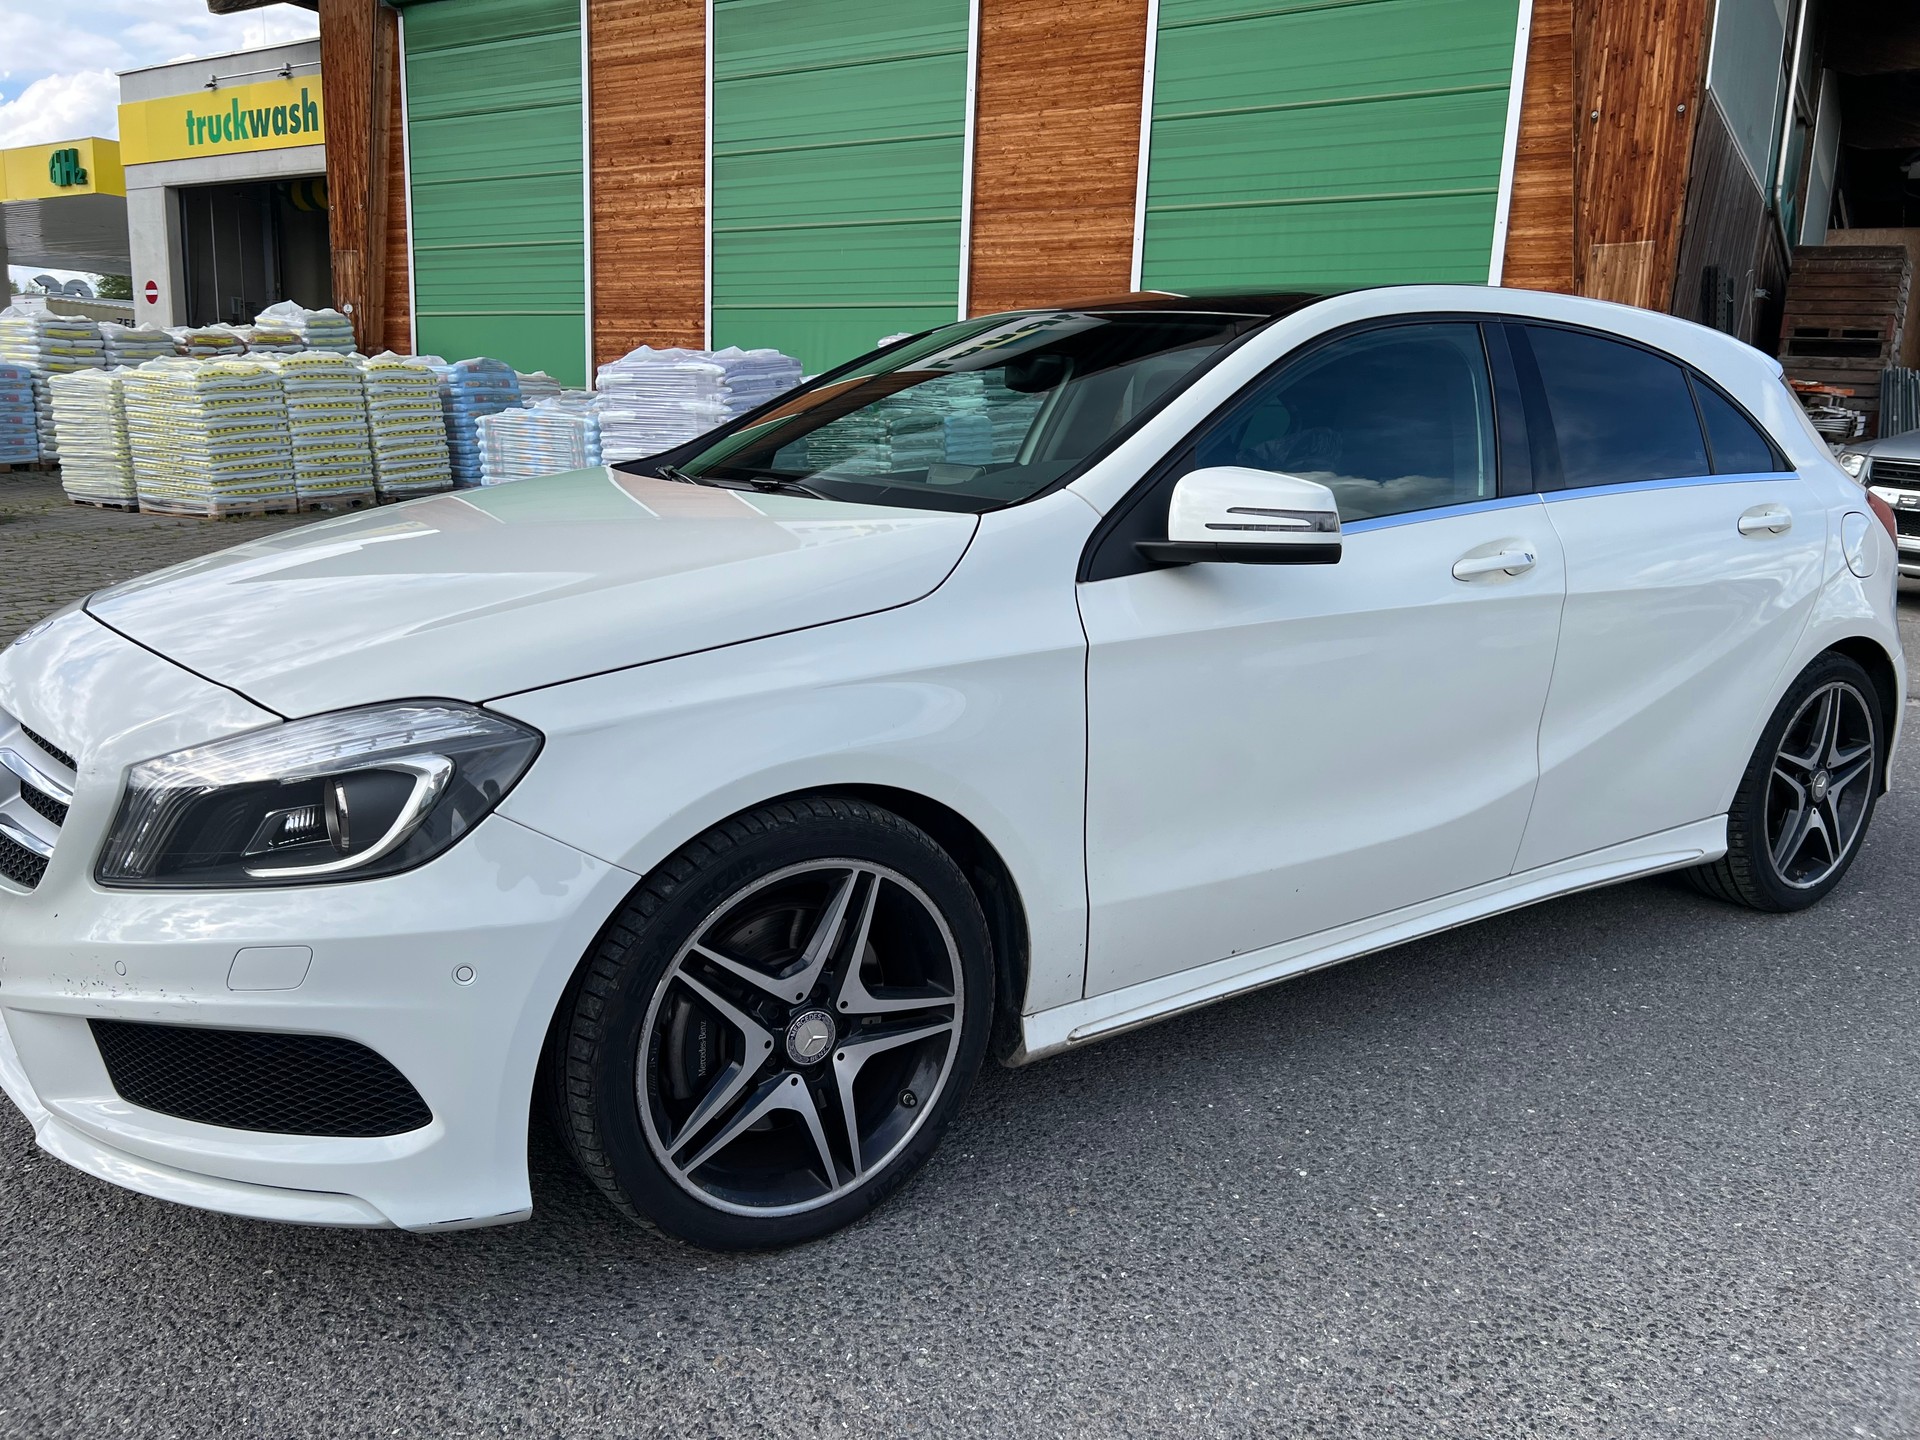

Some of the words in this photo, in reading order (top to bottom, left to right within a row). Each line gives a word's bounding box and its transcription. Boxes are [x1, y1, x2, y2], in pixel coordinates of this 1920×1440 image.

[185, 87, 319, 146] truckwash
[698, 1020, 708, 1077] Mercedes-Benz
[790, 1013, 823, 1037] MERCEDES
